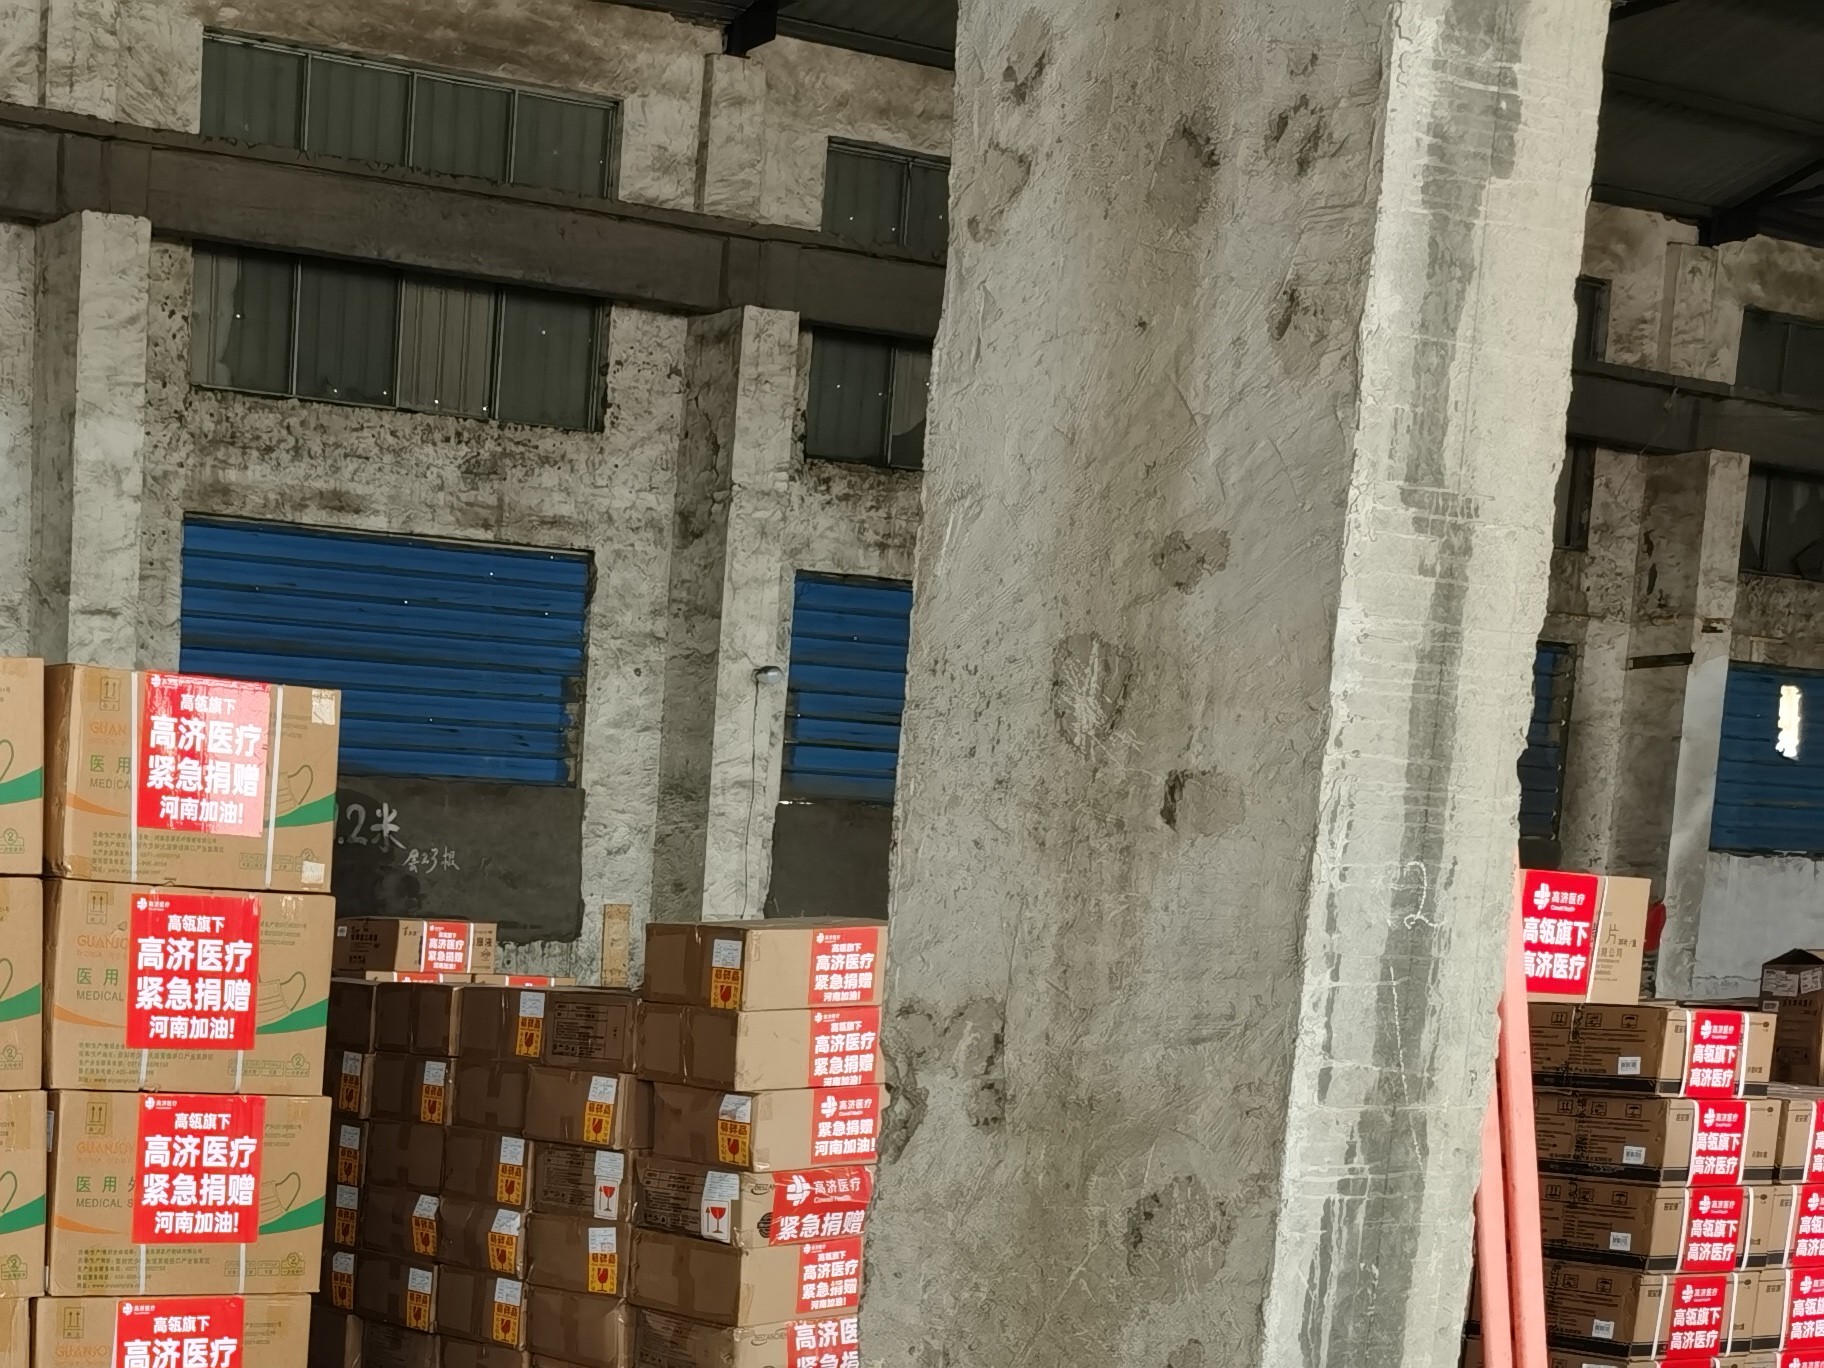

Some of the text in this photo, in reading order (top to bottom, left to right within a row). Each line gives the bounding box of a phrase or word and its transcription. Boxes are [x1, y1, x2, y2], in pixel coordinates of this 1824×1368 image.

[180, 693, 236, 715] 高瓴旗下
[150, 715, 262, 757] 高济医疗
[147, 755, 260, 796] 紧急捐赠
[160, 795, 244, 824] 河南加油!
[1551, 891, 1585, 905] 高济医疗
[168, 915, 225, 933] 高瓴旗下
[1523, 917, 1590, 947] 高瓴旗下
[137, 936, 253, 973] 高济医疗
[816, 952, 874, 972] 高济医疗
[1524, 951, 1586, 980] 高济医疗
[814, 972, 872, 990] 紧急捐赠
[77, 990, 124, 1001] MEDICAL
[136, 976, 251, 1012] 紧急捐赠
[149, 1015, 235, 1039] 河南加油!
[815, 1032, 875, 1054] 高济医疗
[814, 1053, 874, 1076] 紧急捐赠
[1693, 1045, 1737, 1064] 高瓴旗下
[1690, 1068, 1733, 1088] 高济医疗
[838, 1098, 872, 1110] 高济医疗
[174, 1113, 231, 1130] 高瓴旗下
[818, 1119, 873, 1138] 紧急捐赠
[145, 1135, 257, 1168] 高济医疗
[815, 1138, 875, 1156] 河南加油!
[1697, 1132, 1741, 1151] 高瓴旗下
[1694, 1156, 1738, 1175] 高济医疗
[142, 1173, 255, 1207] 紧急捐赠
[814, 1177, 860, 1194] 高济医疗
[76, 1198, 130, 1208] MEDICAL
[155, 1211, 238, 1234] 河南加油!
[778, 1210, 864, 1240] 紧急捐赠
[1691, 1219, 1738, 1238] 高瓴旗下
[1687, 1242, 1735, 1262] 高济医疗
[803, 1259, 858, 1280] 高济医疗
[802, 1278, 856, 1300] 紧急捐赠
[153, 1316, 210, 1333] 高瓴旗下
[1674, 1307, 1722, 1327] 高瓴旗下
[1670, 1330, 1718, 1350] 高济医疗
